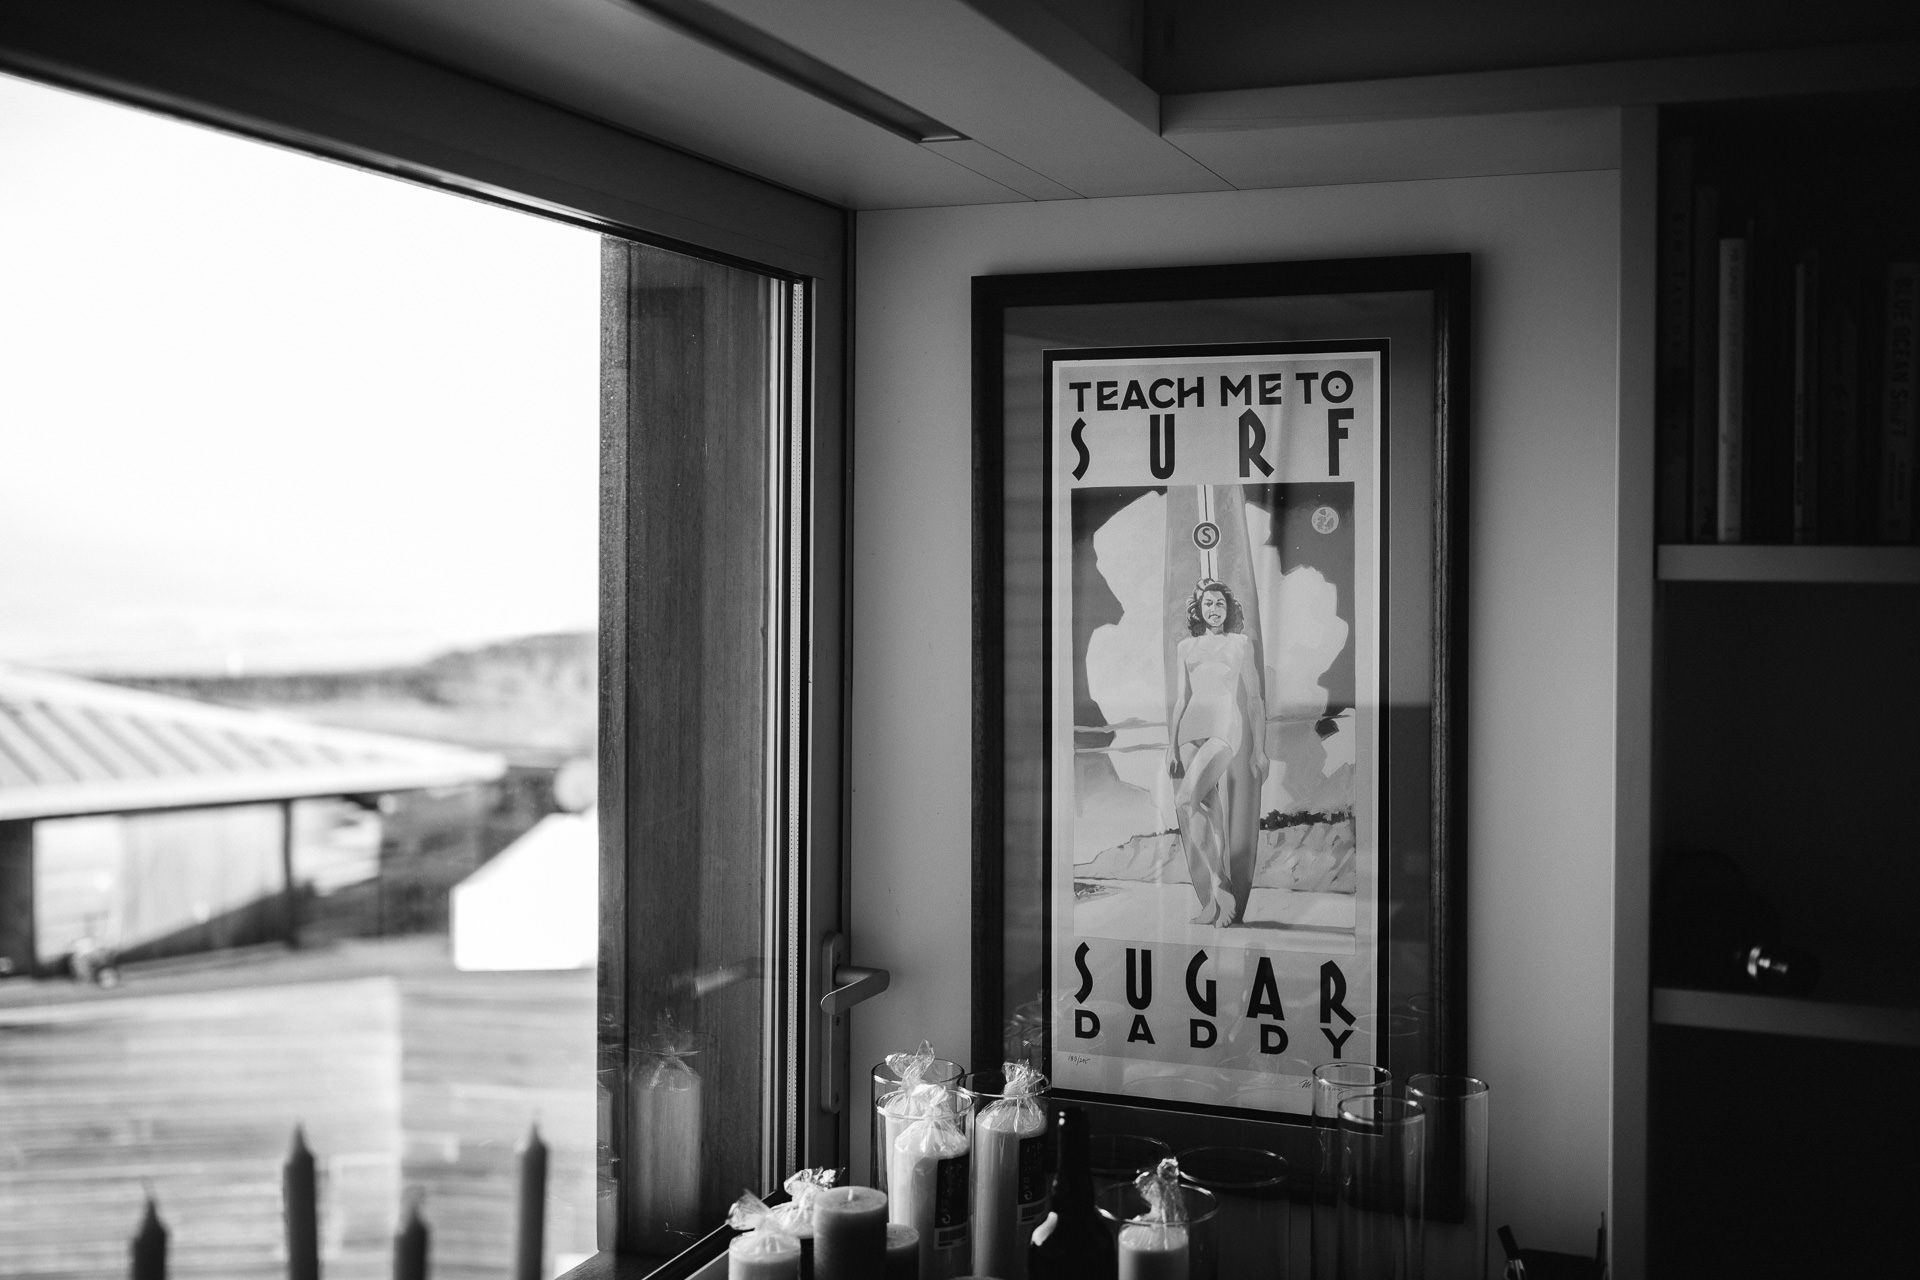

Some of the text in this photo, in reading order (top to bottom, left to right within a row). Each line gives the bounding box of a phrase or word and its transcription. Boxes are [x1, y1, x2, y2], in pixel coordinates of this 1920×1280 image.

[1069, 370, 1354, 412] TEACH ME TO
[1070, 408, 1355, 481] SURF
[1074, 941, 1357, 1027] SUGAR
[1074, 1009, 1354, 1060] DADDY
